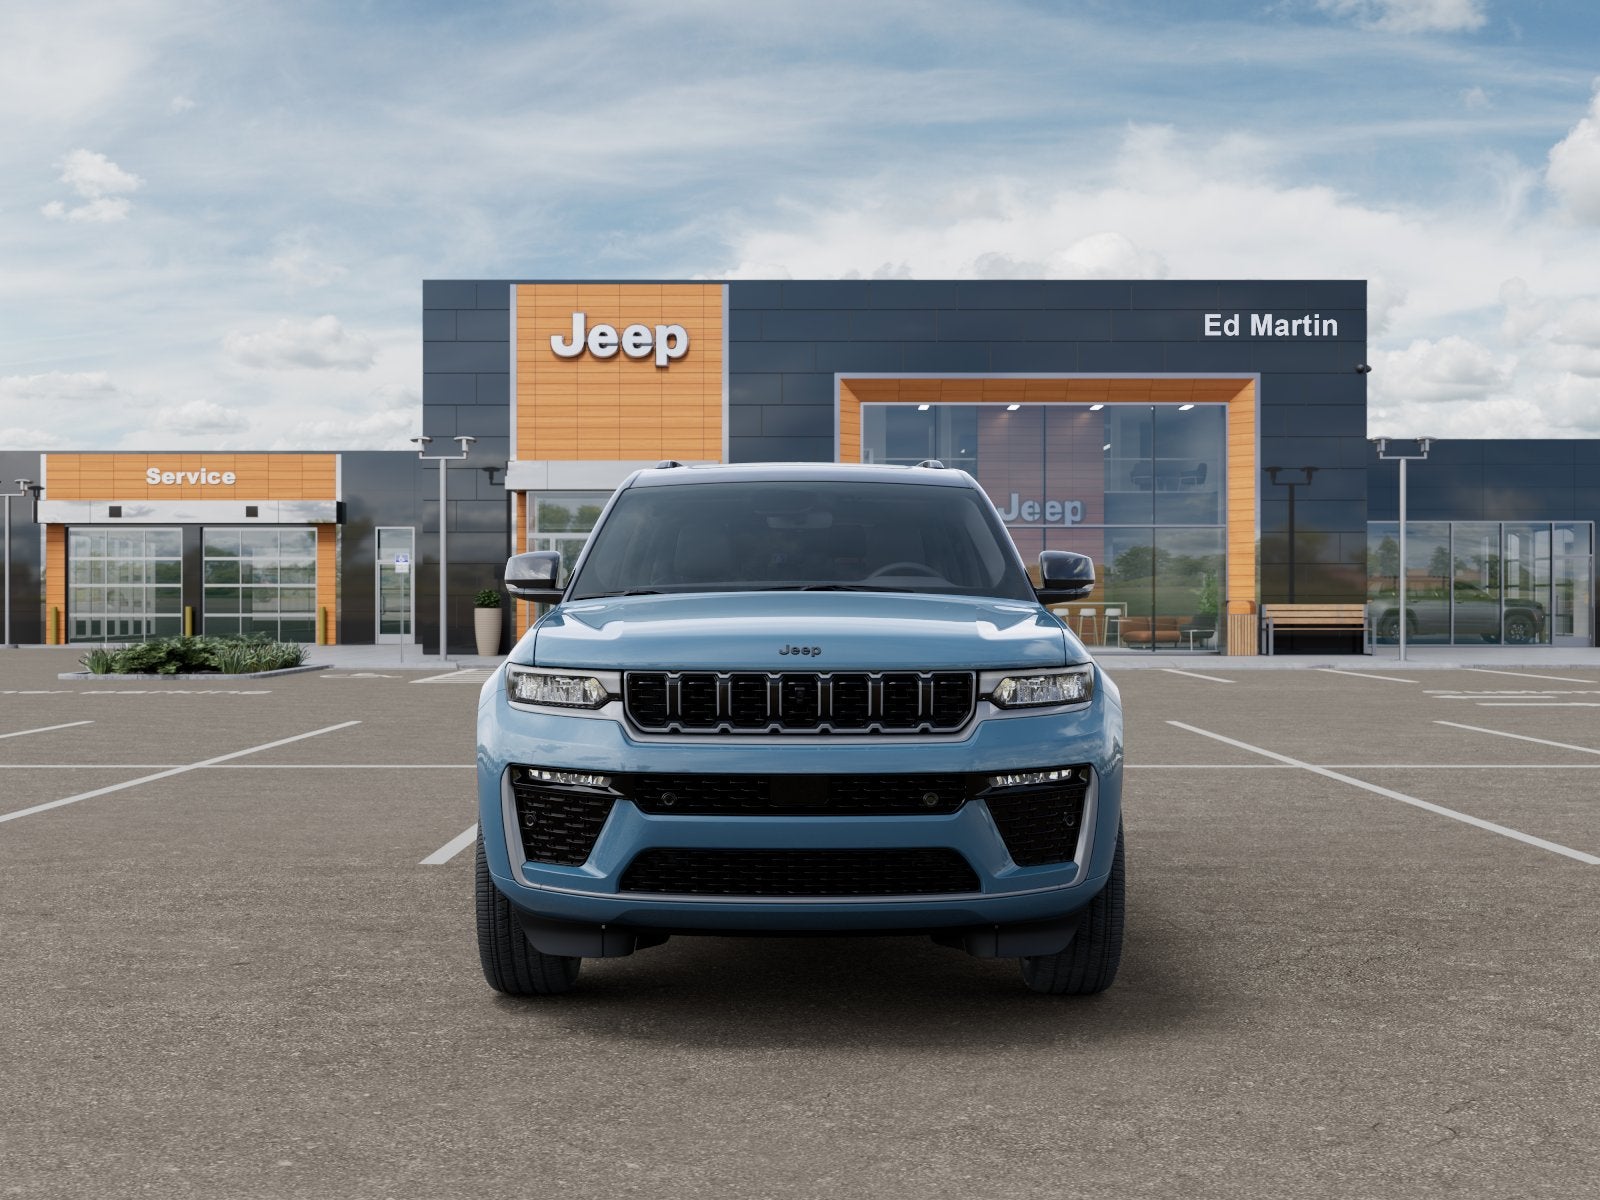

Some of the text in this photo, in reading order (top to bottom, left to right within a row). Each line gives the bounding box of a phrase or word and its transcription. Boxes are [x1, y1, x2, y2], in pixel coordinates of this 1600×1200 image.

[1204, 313, 1338, 337] Ed Martin
[550, 312, 689, 368] Jeep
[146, 467, 237, 485] Service
[998, 493, 1083, 527] Jeep
[779, 644, 822, 658] Jeep
